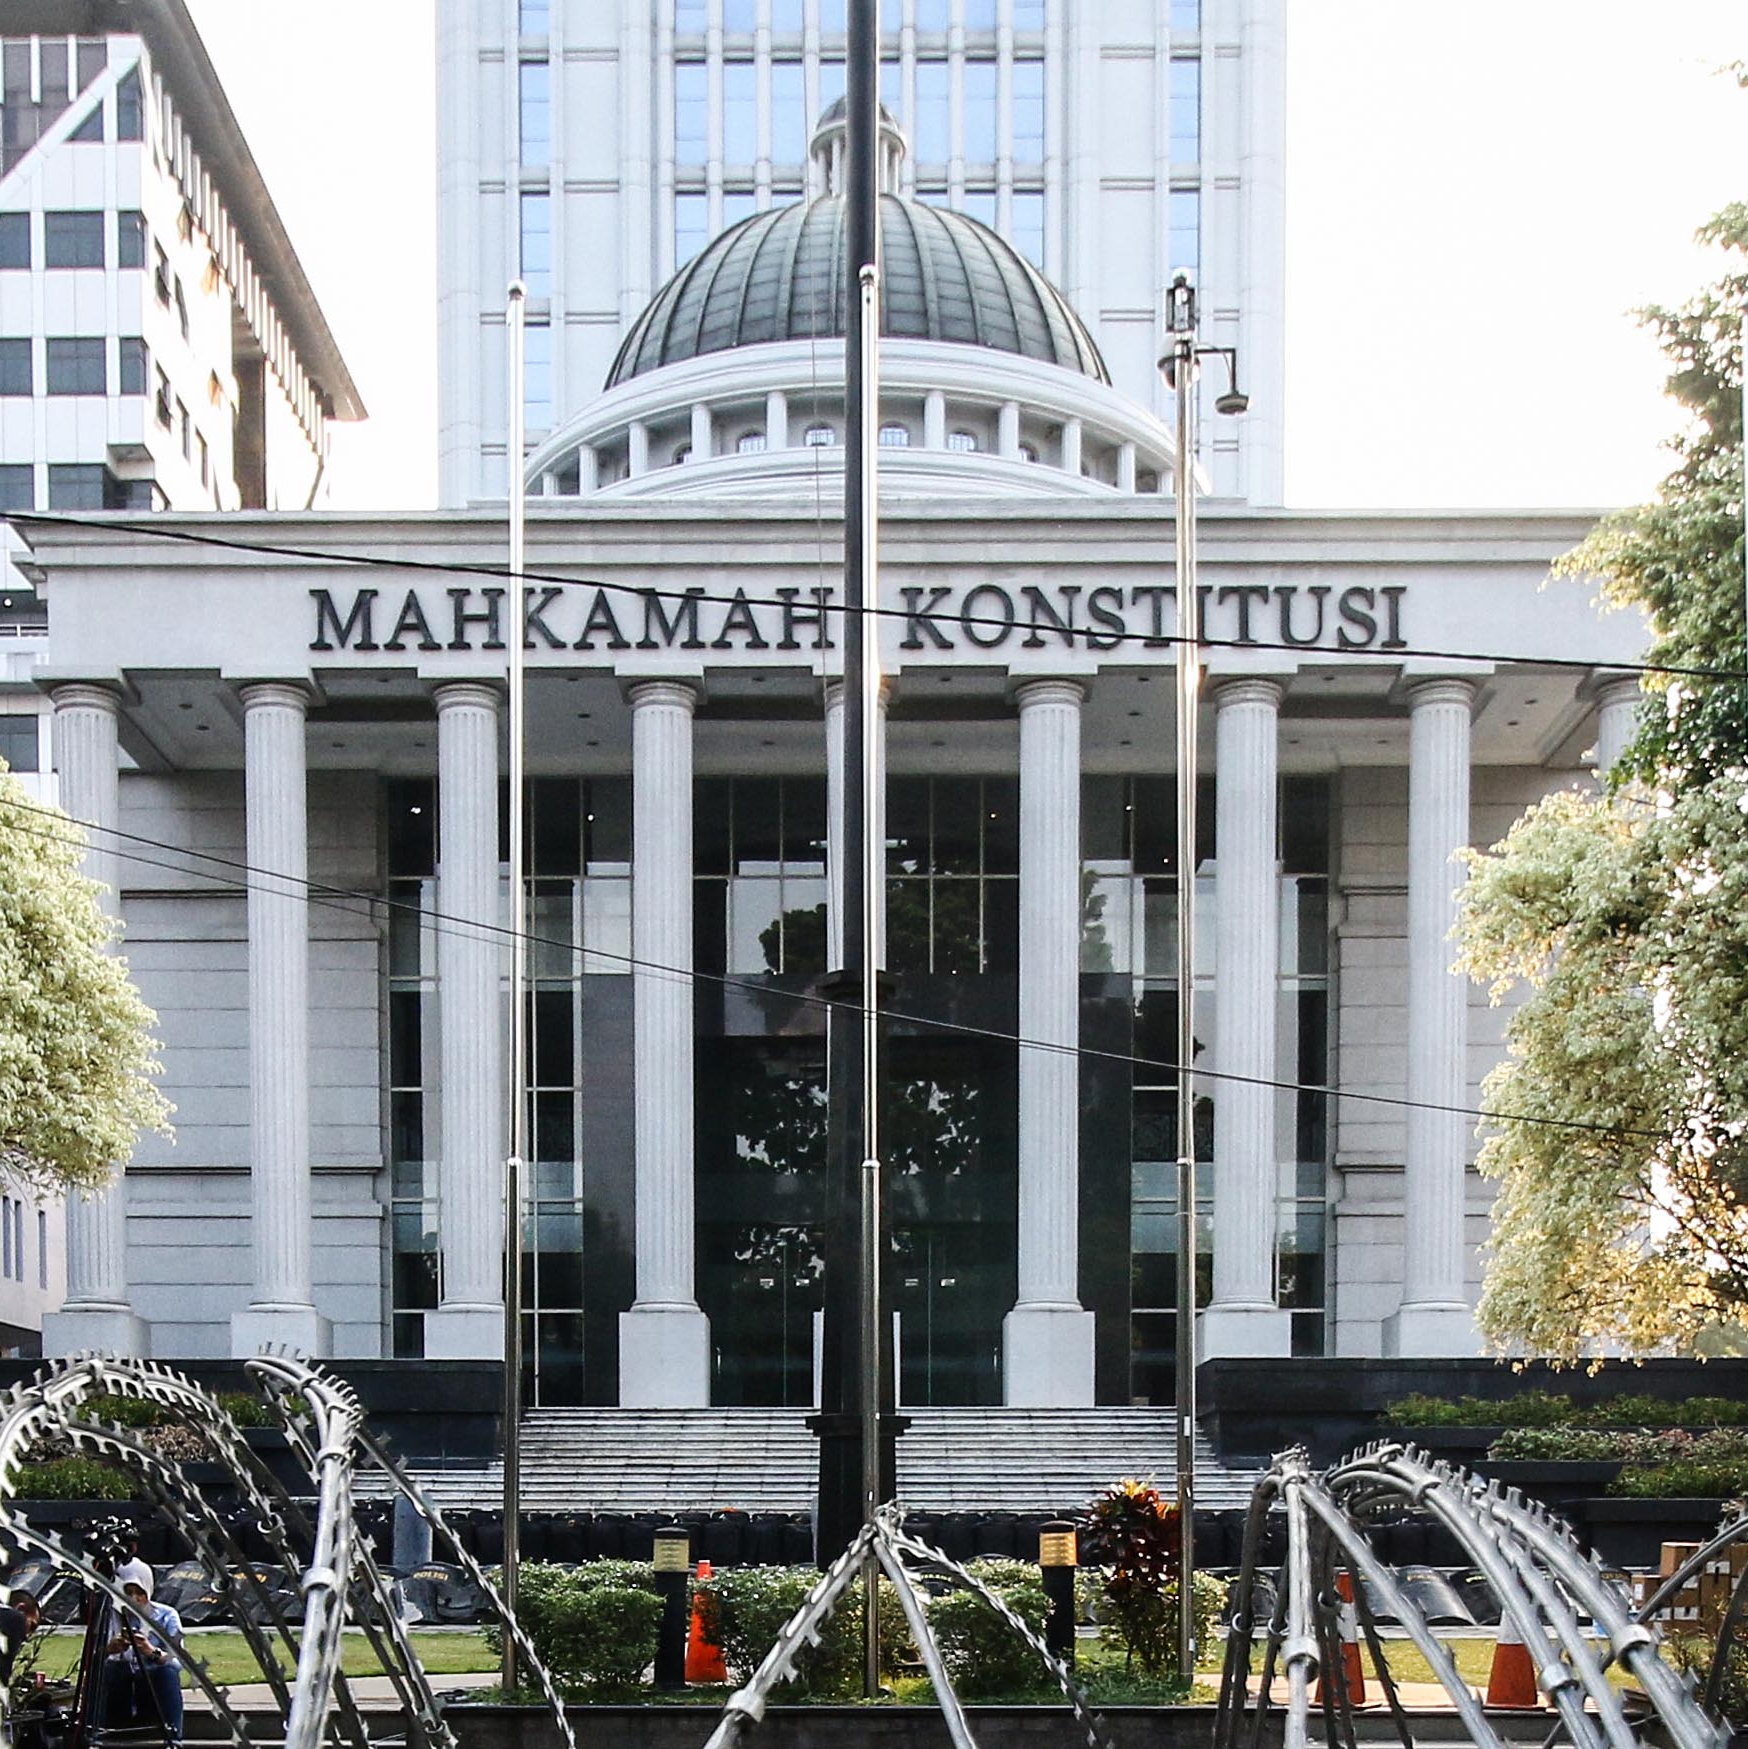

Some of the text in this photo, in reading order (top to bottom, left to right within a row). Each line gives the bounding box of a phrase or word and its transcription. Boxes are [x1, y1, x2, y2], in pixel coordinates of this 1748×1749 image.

[308, 584, 1408, 651] MAHKAMAH KONSTITUSI
[413, 1573, 449, 1584] POLISI
